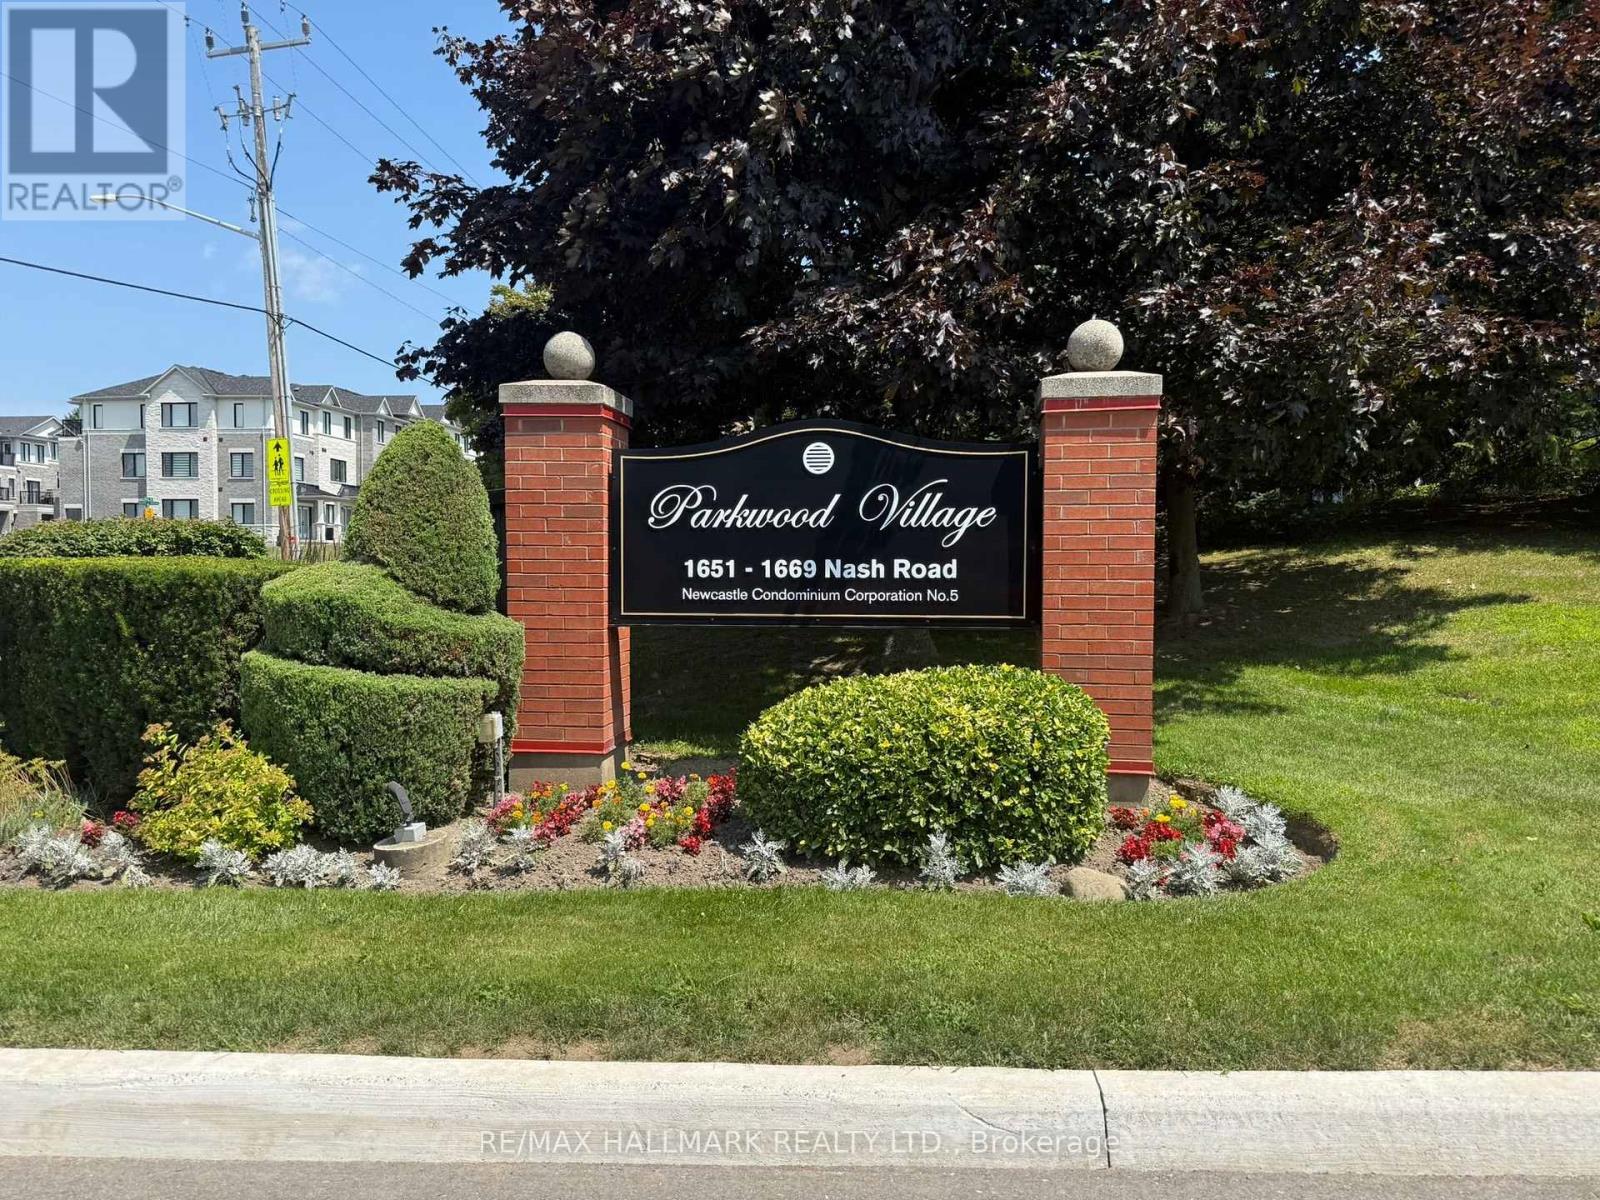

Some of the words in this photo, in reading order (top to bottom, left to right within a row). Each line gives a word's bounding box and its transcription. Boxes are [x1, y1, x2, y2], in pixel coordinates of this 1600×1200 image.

[648, 485, 841, 529] Parkwood
[859, 479, 997, 548] Village
[684, 559, 735, 578] 1651
[761, 559, 817, 578] 1669
[824, 559, 885, 579] Nash
[893, 559, 957, 579] Road
[682, 588, 748, 601] Newcastle
[752, 588, 841, 601] Condominium
[844, 588, 922, 605] Corporation
[926, 589, 959, 602] No.5
